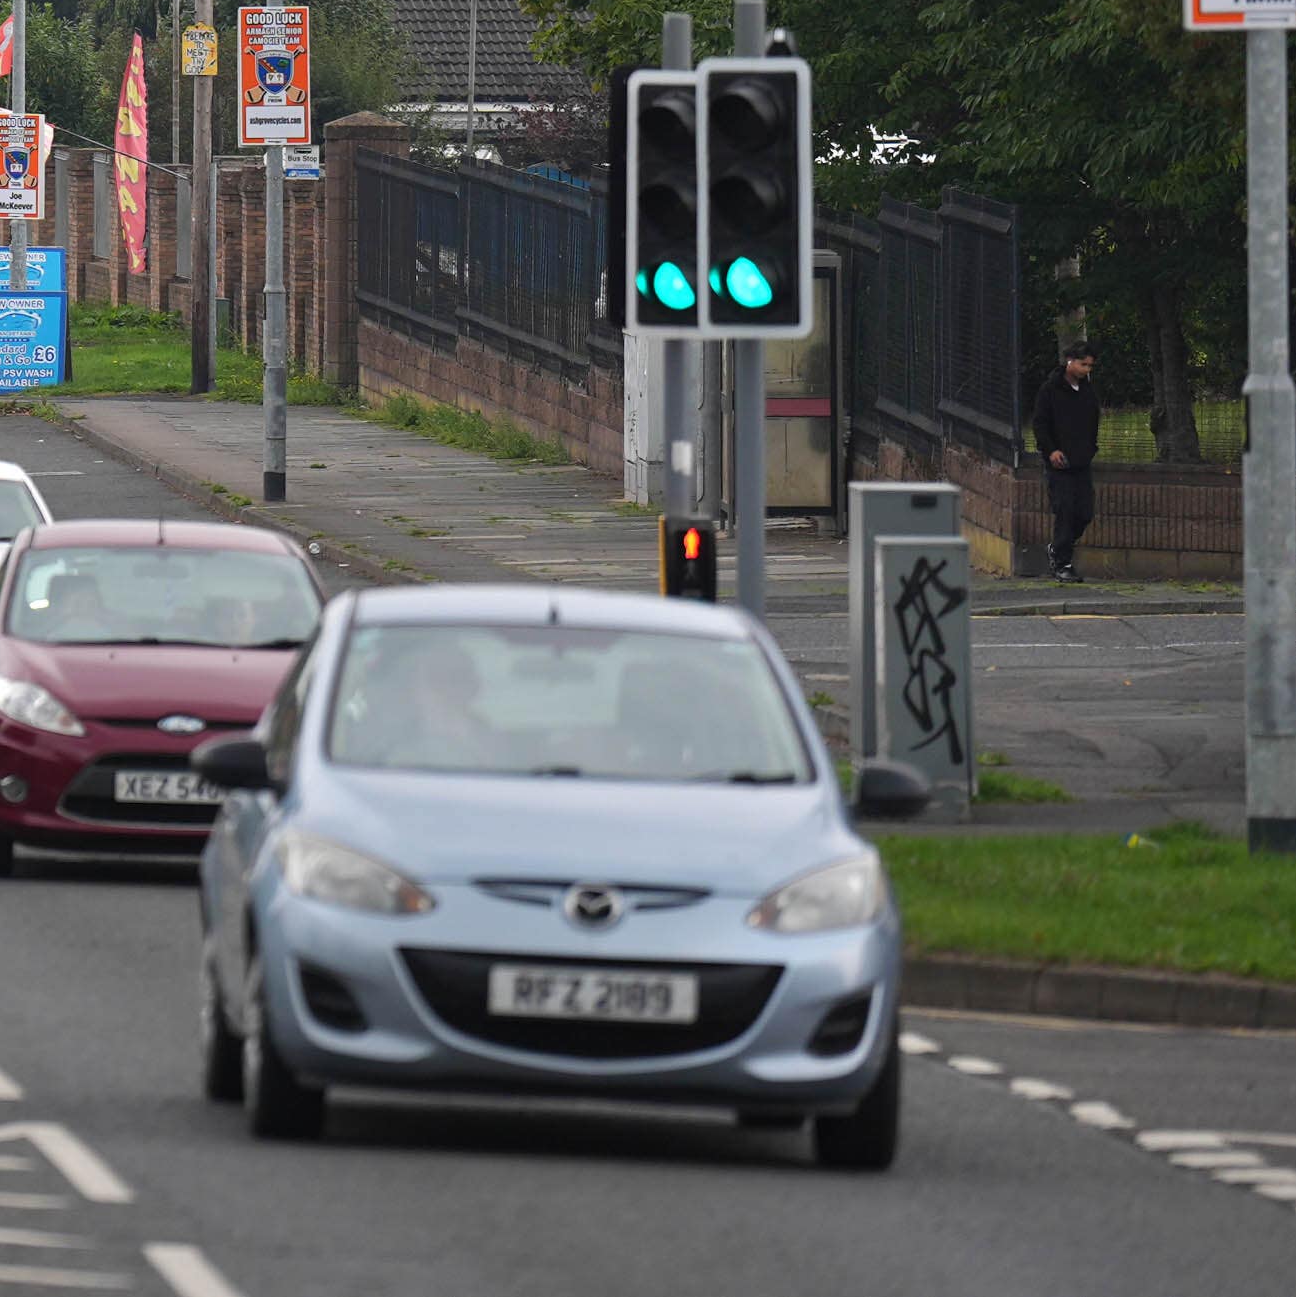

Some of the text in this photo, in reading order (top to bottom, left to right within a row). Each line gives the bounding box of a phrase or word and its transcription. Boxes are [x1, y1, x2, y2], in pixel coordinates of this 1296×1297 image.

[246, 12, 303, 25] GOOD LUCK
[277, 27, 303, 35] SENIOR
[248, 37, 300, 45] CAMOGIE TEAM
[17, 117, 36, 128] LUCK
[303, 155, 318, 164] Stop
[9, 192, 23, 200] Joe
[24, 252, 46, 262] NER
[7, 299, 44, 309] OWNER
[33, 345, 56, 363] £6
[4, 354, 13, 365] &
[15, 354, 32, 365] Go
[2, 369, 23, 378] PSV
[24, 369, 54, 378] WASH
[125, 775, 169, 799] XEZ
[512, 974, 582, 1014] RFZ
